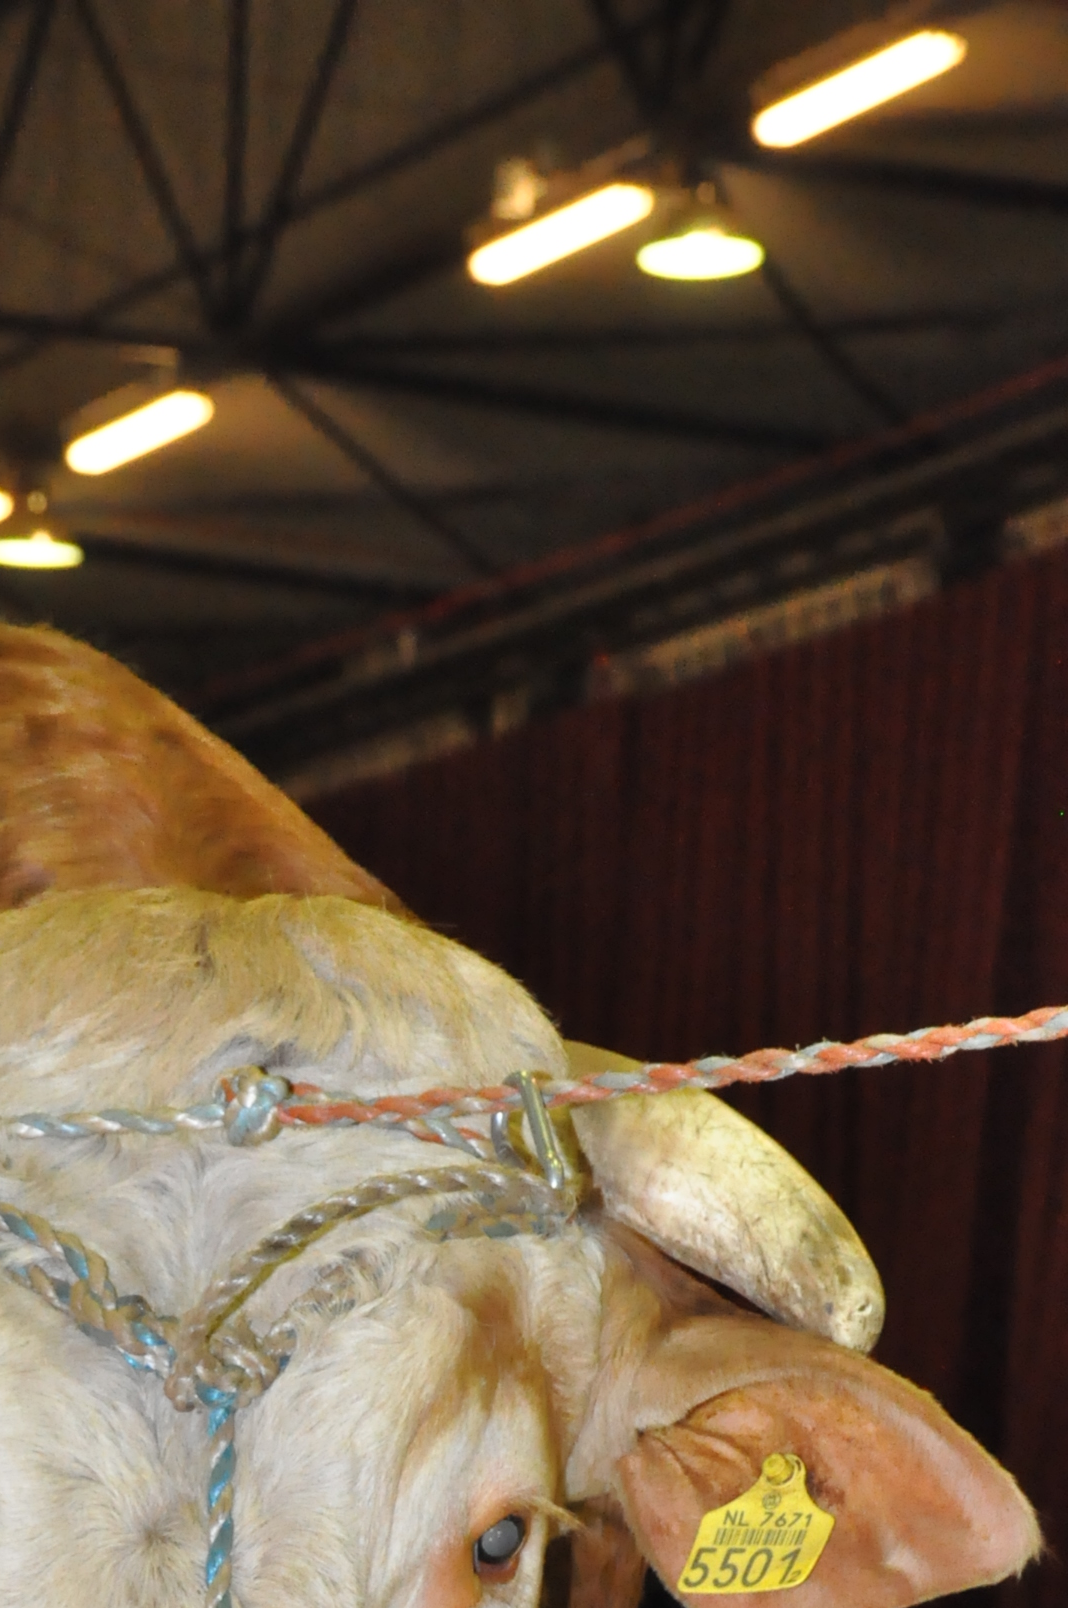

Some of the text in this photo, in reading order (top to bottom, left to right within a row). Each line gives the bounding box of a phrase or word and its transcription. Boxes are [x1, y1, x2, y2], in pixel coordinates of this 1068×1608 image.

[723, 1510, 813, 1527] NL 7671
[683, 1547, 801, 1588] 5501
